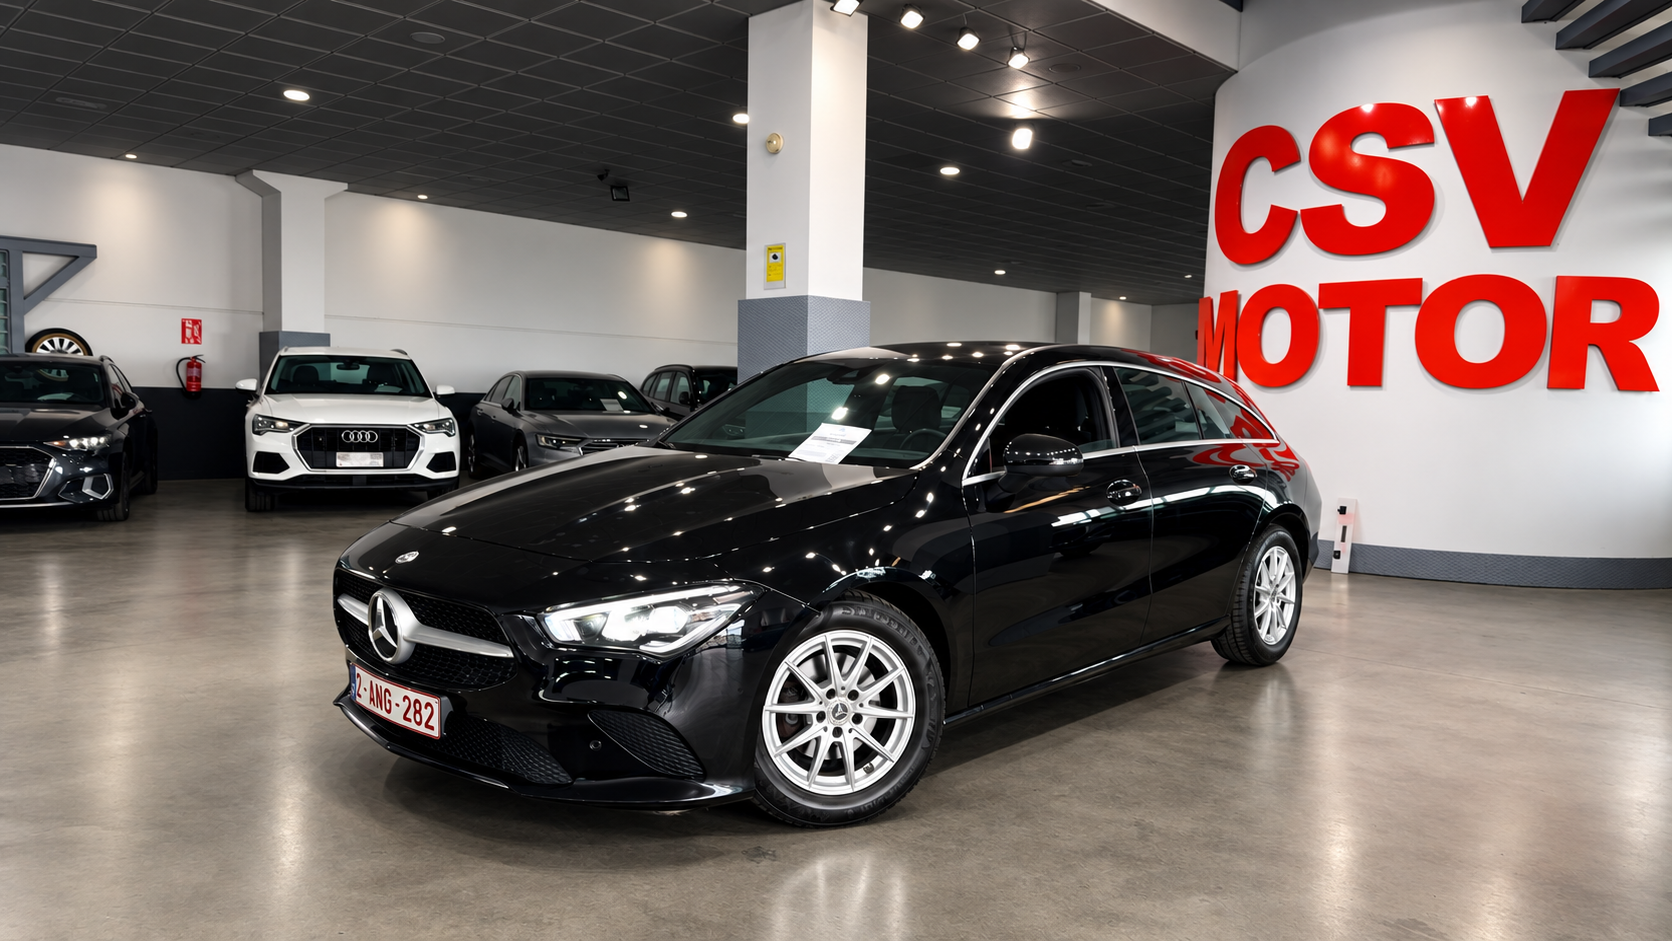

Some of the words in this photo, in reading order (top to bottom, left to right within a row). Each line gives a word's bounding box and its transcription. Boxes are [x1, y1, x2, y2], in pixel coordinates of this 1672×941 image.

[1214, 88, 1620, 265] CSV
[1197, 273, 1660, 392] MOTOR
[356, 672, 435, 731] 2-ANG-282
